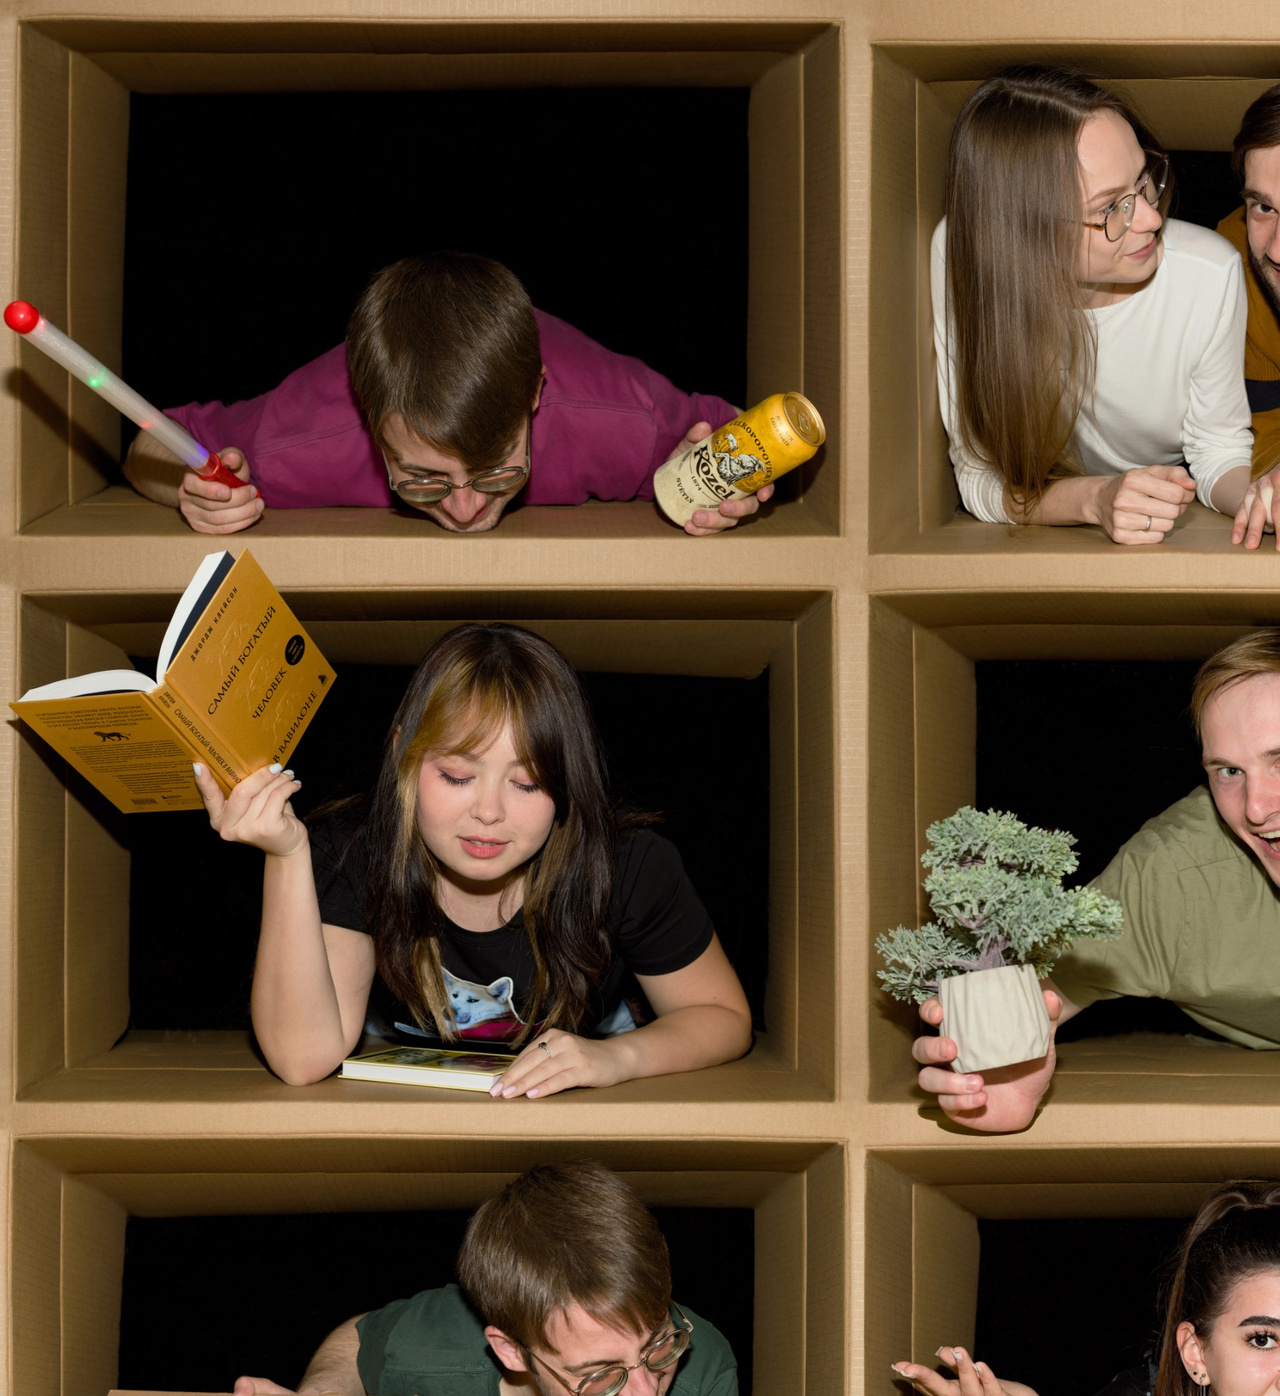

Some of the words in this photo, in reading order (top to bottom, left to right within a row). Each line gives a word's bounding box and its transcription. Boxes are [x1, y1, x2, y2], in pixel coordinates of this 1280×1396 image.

[694, 444, 735, 500] Kozel
[191, 626, 213, 662] ДЖОРДЖ
[214, 587, 238, 623] КЛЕЙСОН
[208, 664, 240, 715] САМЫЙ
[239, 606, 276, 666] БОГАТЫЙ
[252, 667, 287, 719] ЧЕЛОВЕК
[173, 707, 193, 728] САМЫЙ
[188, 725, 211, 749] БОГАТЫЙ
[207, 746, 226, 766] ЧЕЛОВЕК
[273, 754, 280, 763] В
[278, 690, 318, 754] ВАВИЛОНЕ
